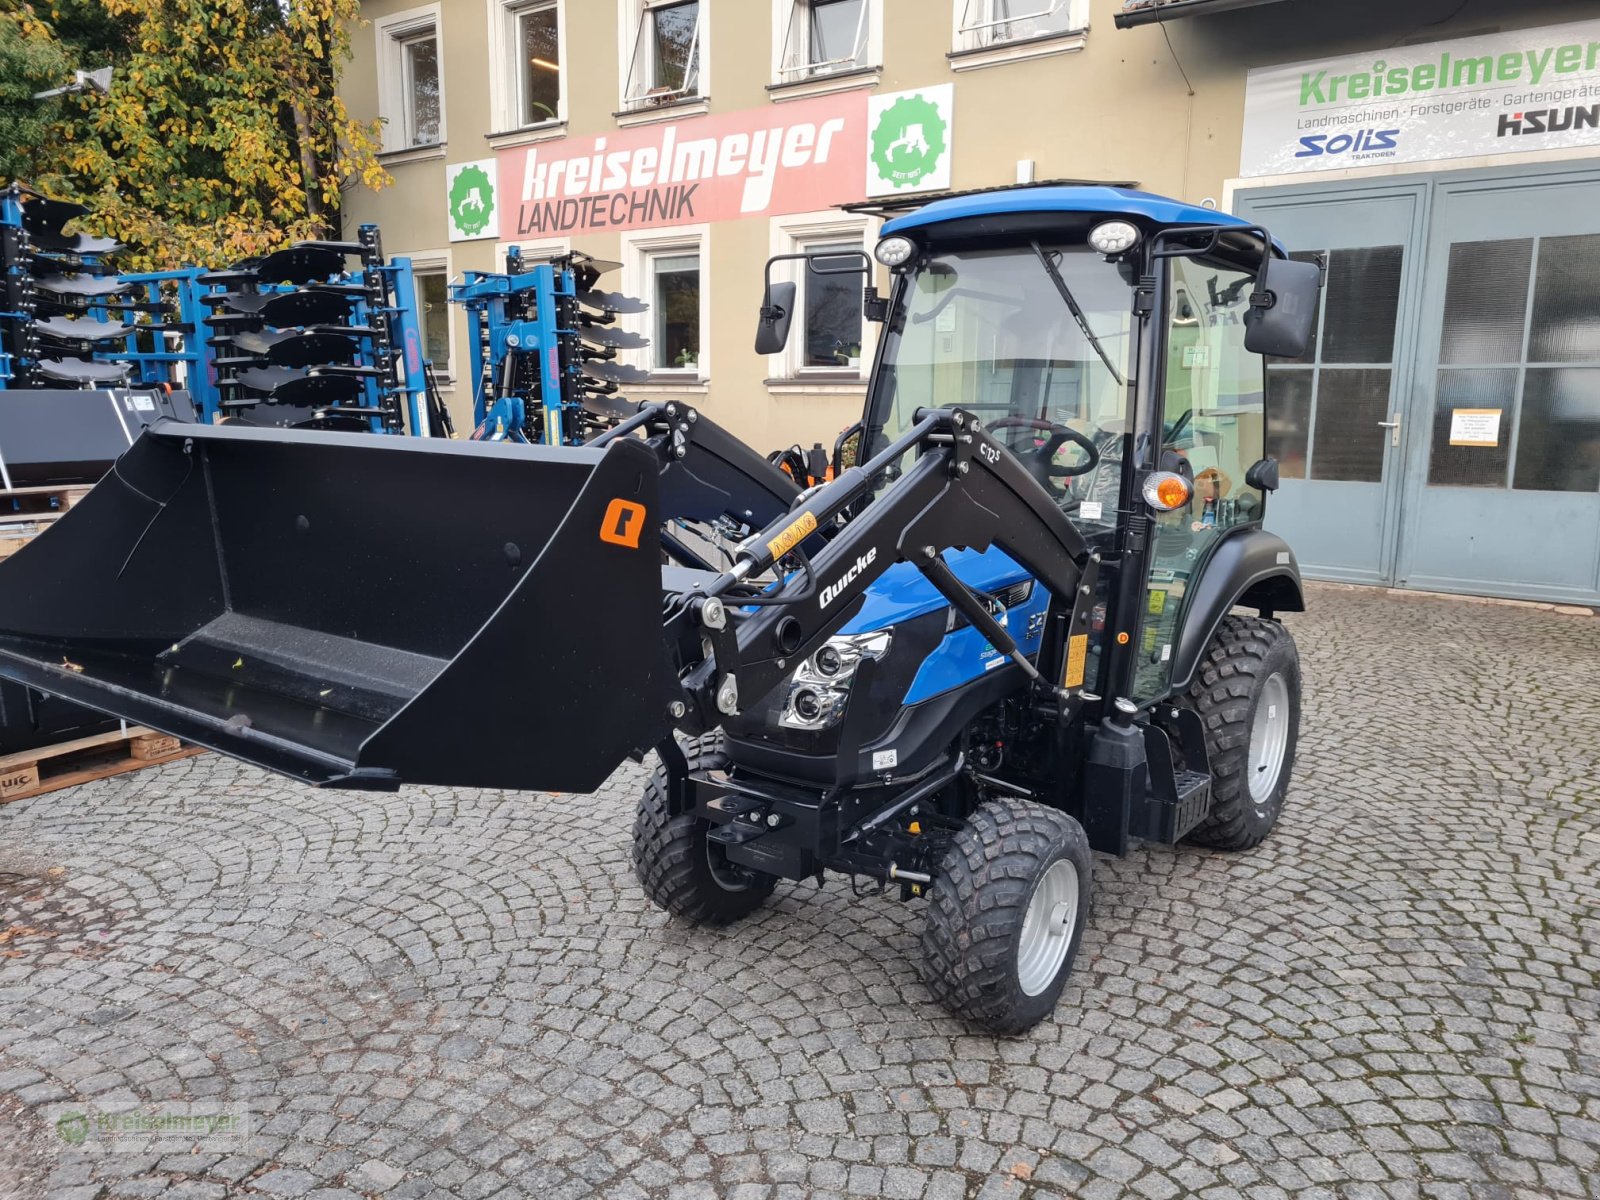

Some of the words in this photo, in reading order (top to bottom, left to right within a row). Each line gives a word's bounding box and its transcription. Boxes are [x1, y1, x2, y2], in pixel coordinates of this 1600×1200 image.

[1299, 41, 1600, 106] Kreiselmeyer
[1297, 107, 1399, 130] Landmaschinen
[1409, 97, 1491, 117] Forstgeräte
[1503, 84, 1600, 106] Gartengeräte
[522, 117, 845, 213] kreiselmeyer
[1352, 151, 1396, 161] TRAKTOREN
[517, 183, 700, 235] LANDTECHNIK
[819, 546, 877, 610] Quicke
